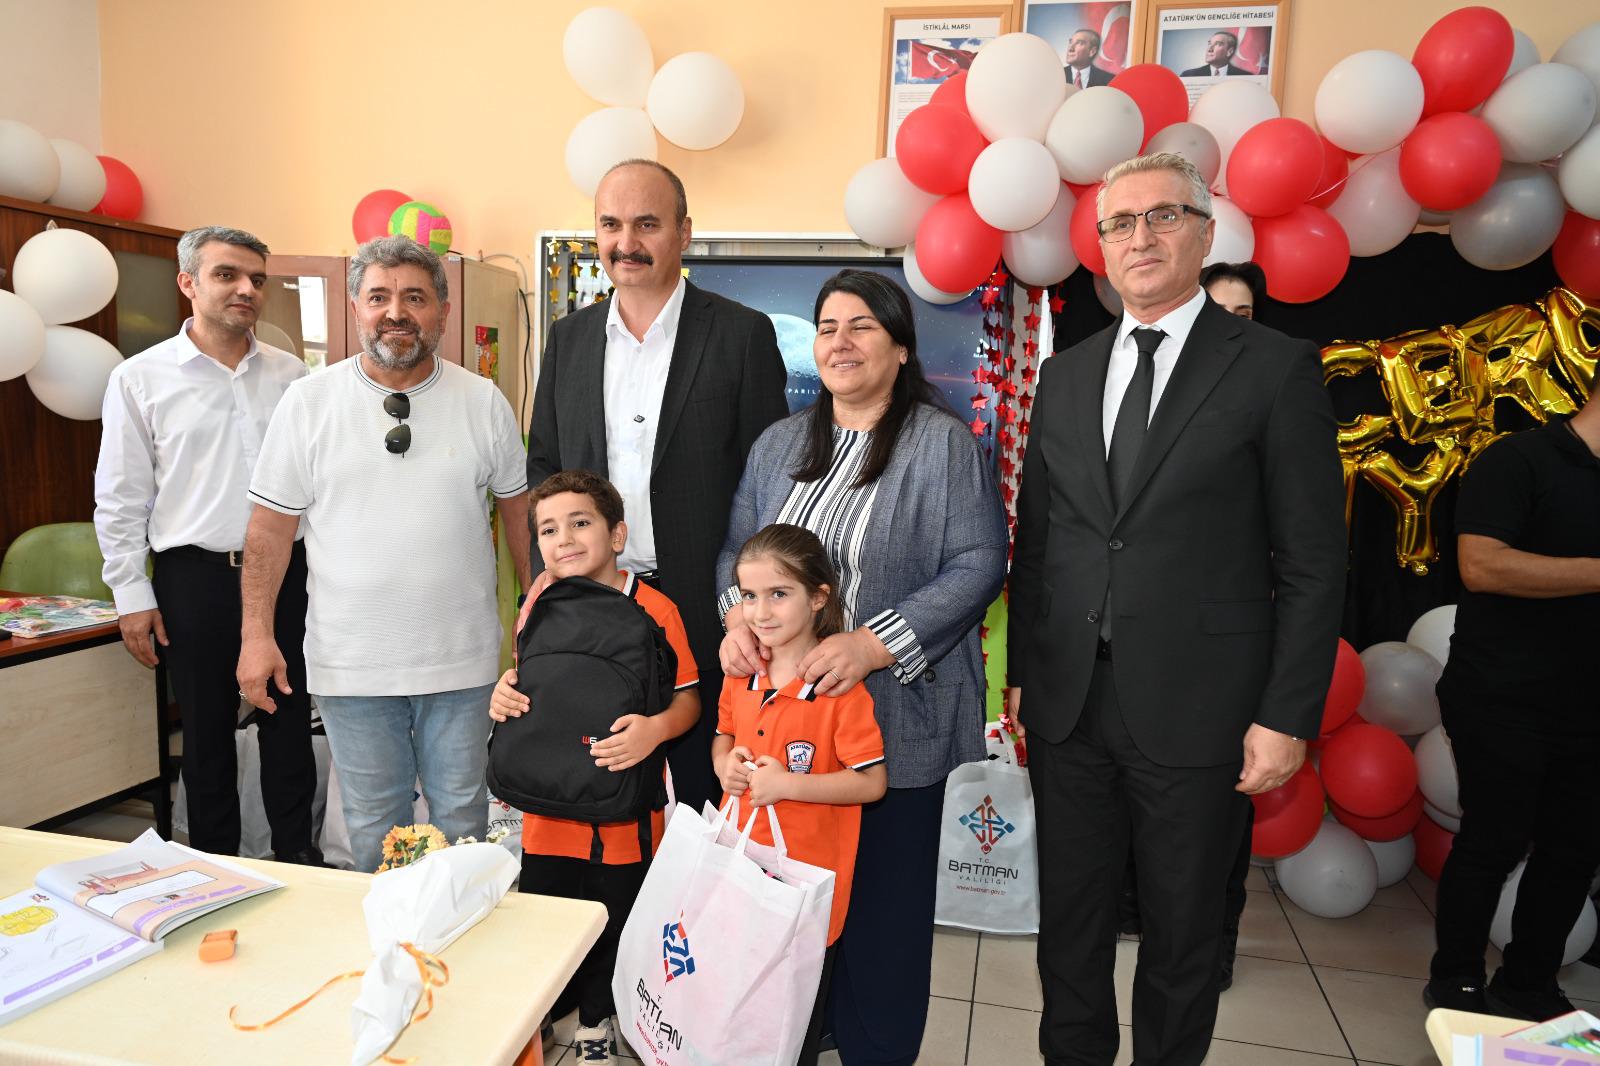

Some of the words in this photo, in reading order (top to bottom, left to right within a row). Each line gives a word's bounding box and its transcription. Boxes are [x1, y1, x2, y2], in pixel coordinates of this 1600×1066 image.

[1163, 13, 1206, 22] ATATÜRK'ÜN
[1207, 12, 1241, 21] GENÇLİĞE
[1242, 10, 1275, 19] HİTABESİ
[948, 859, 1019, 880] BATMAN
